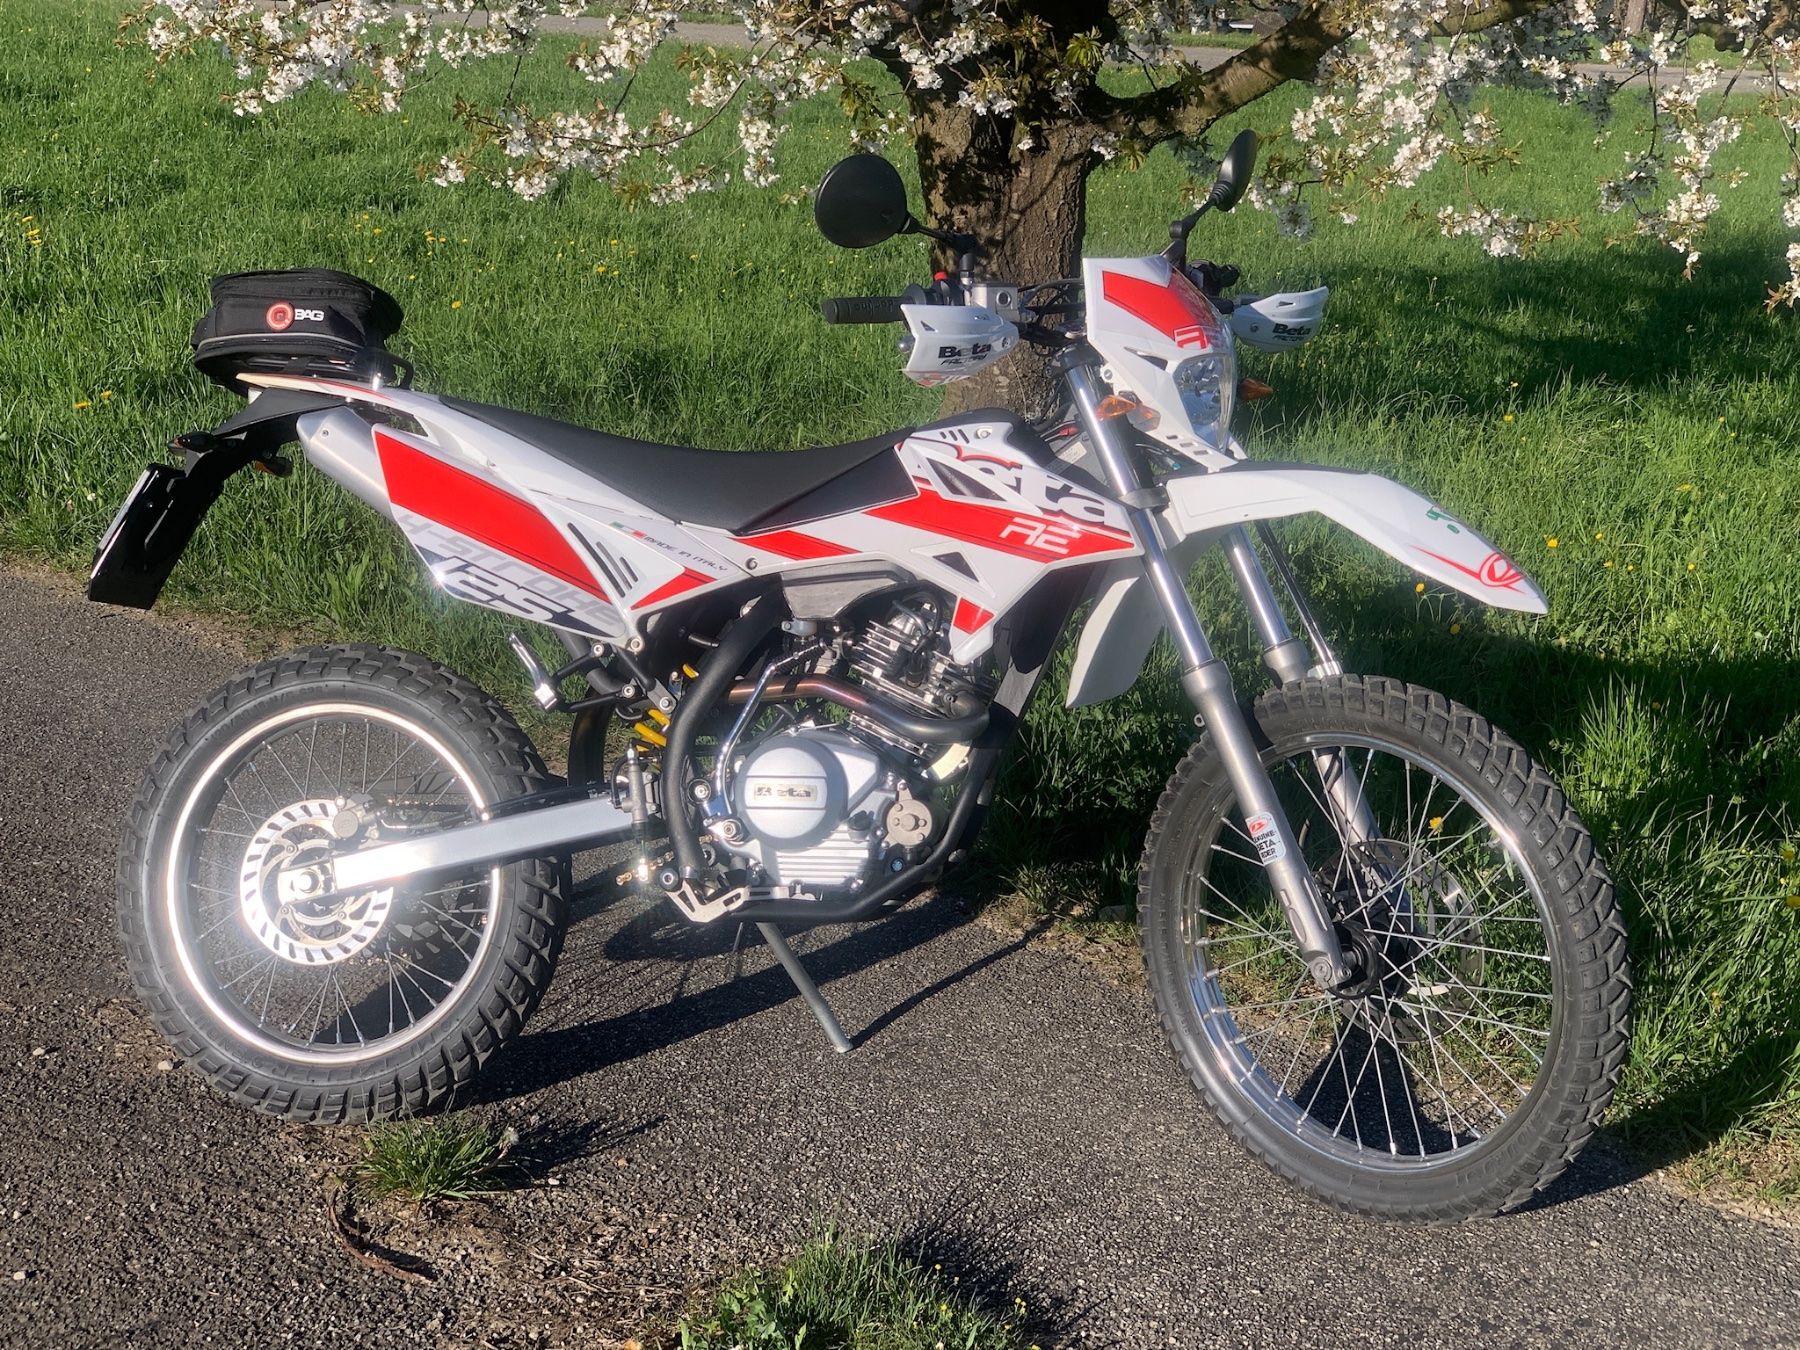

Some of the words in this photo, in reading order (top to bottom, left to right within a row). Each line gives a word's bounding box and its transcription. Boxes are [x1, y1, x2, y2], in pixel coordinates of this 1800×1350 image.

[1272, 322, 1312, 336] Beta
[938, 342, 992, 359] Beta
[1256, 838, 1277, 852] ETA
